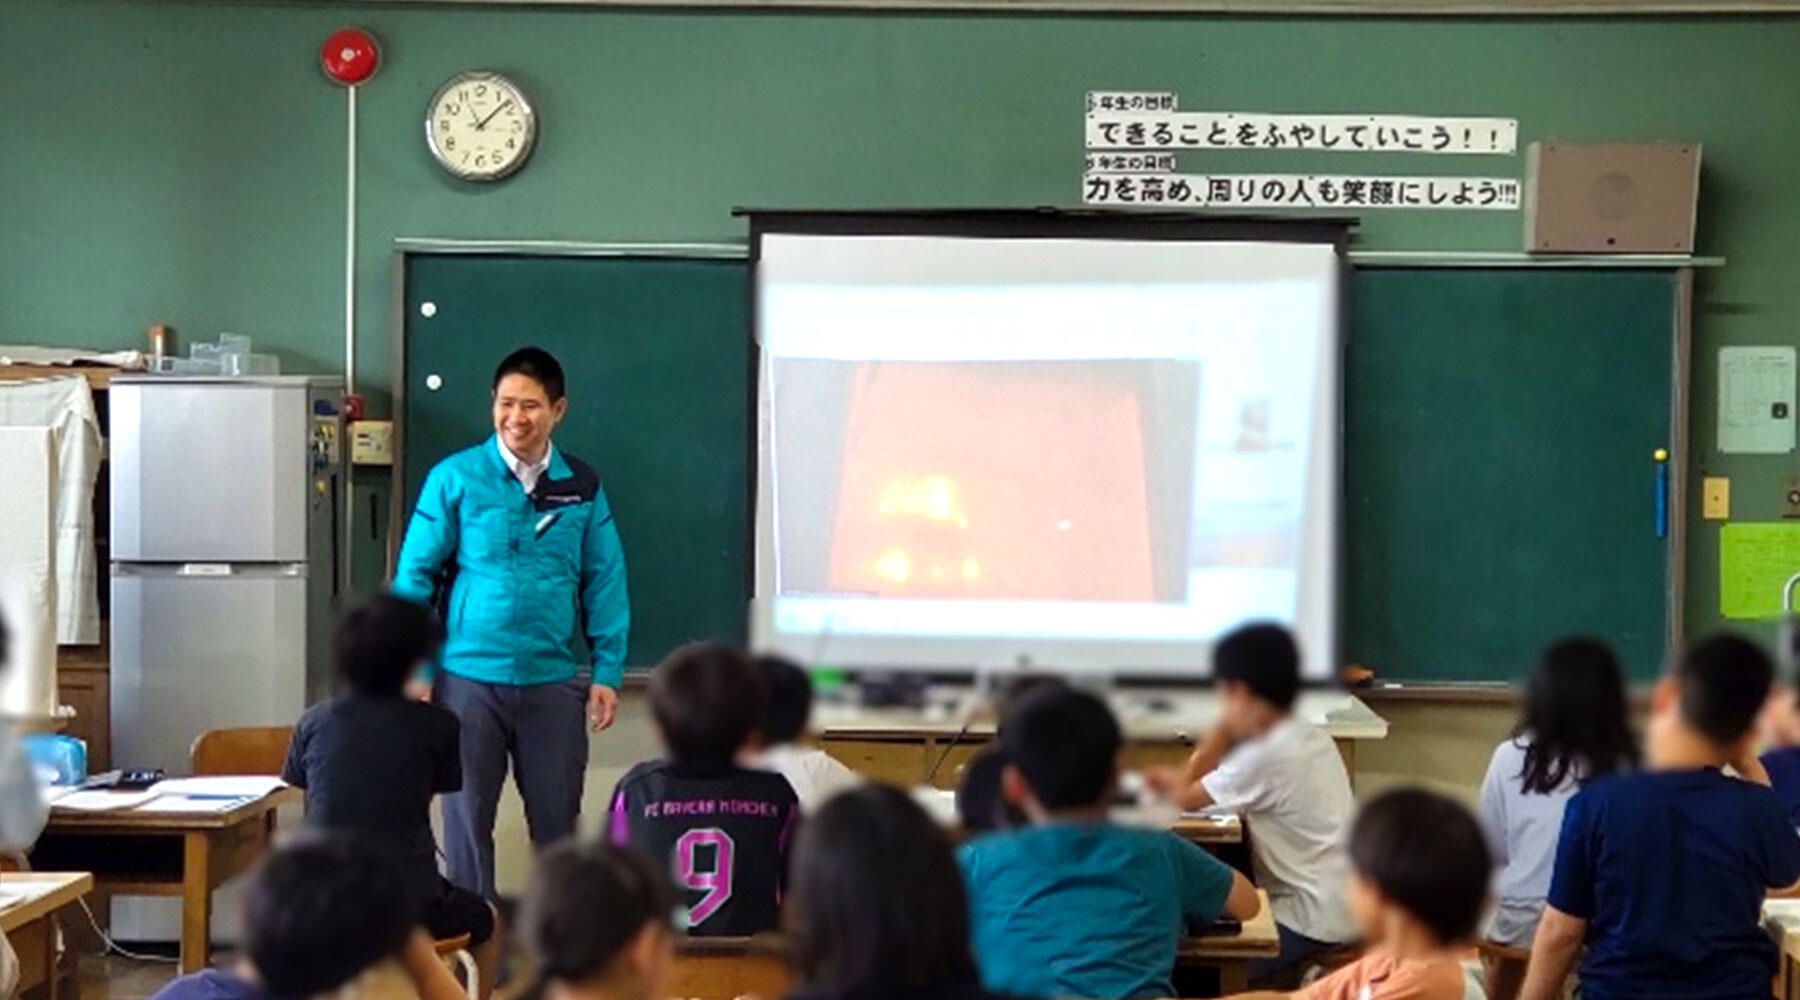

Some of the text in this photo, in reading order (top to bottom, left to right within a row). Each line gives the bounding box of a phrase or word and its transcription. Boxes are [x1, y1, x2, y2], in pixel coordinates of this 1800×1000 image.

[458, 91, 469, 102] 11
[496, 91, 502, 102] 1
[444, 102, 461, 116] 10
[1098, 120, 1497, 149] できることをふやしていこう！！
[505, 138, 515, 149] 4
[677, 827, 735, 927] 9
